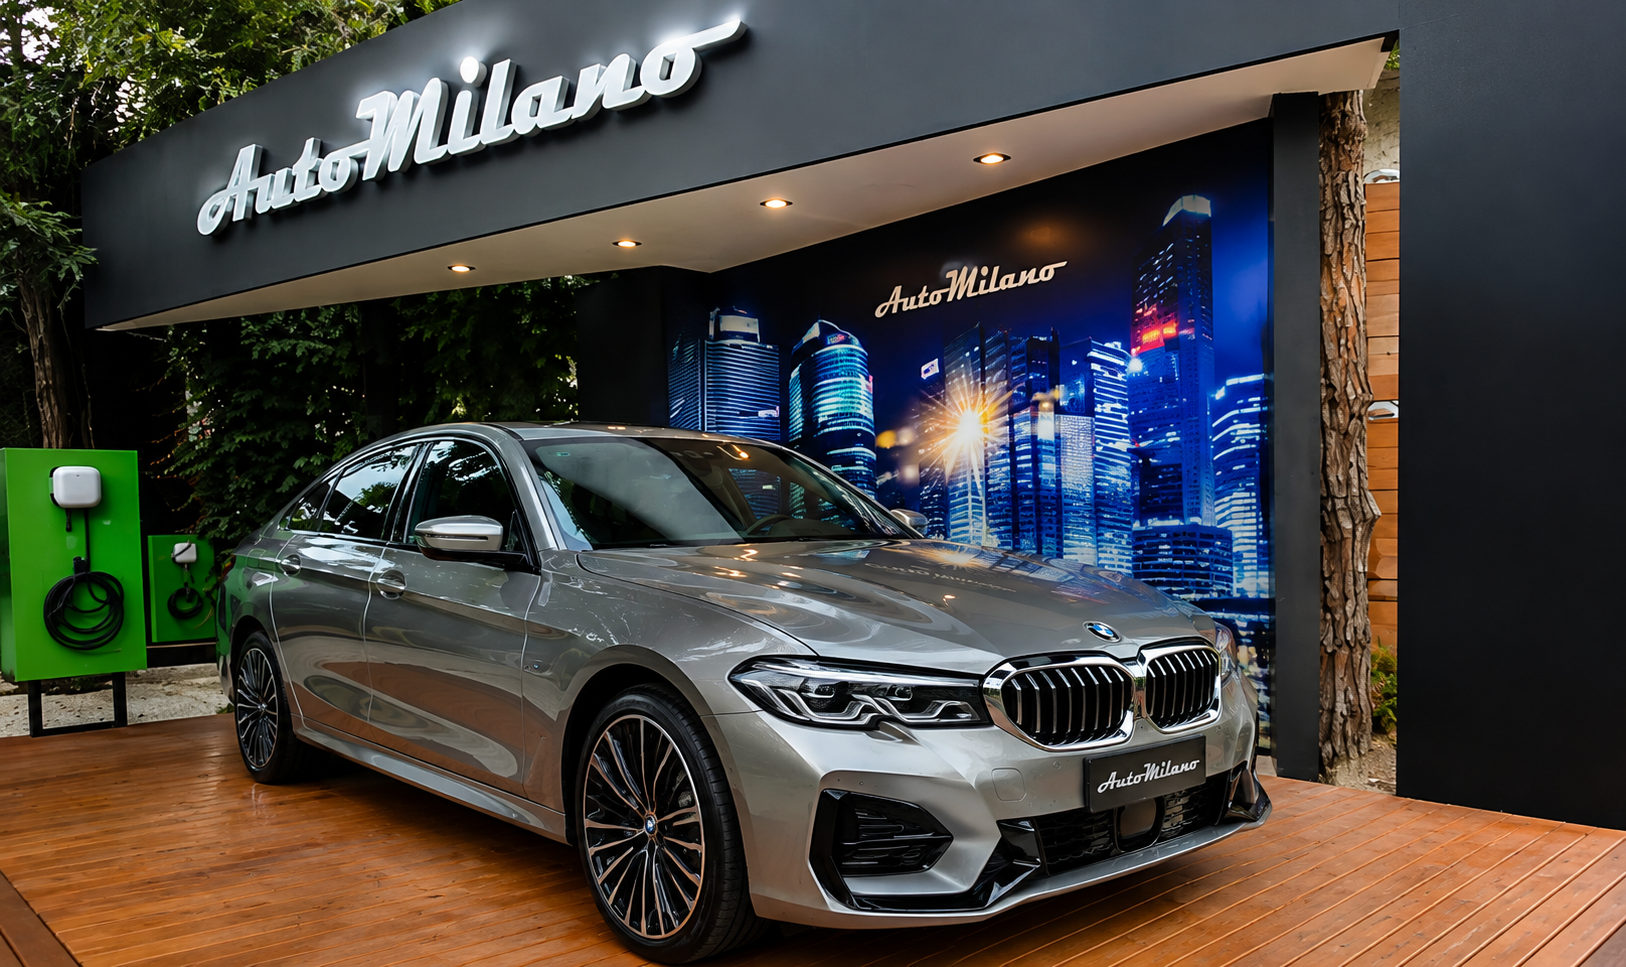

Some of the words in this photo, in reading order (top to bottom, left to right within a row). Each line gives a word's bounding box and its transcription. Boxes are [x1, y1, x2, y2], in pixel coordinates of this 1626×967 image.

[196, 19, 747, 235] AutoMilano
[874, 260, 1068, 318] AutoMilano
[1097, 760, 1200, 794] AutoMilano
